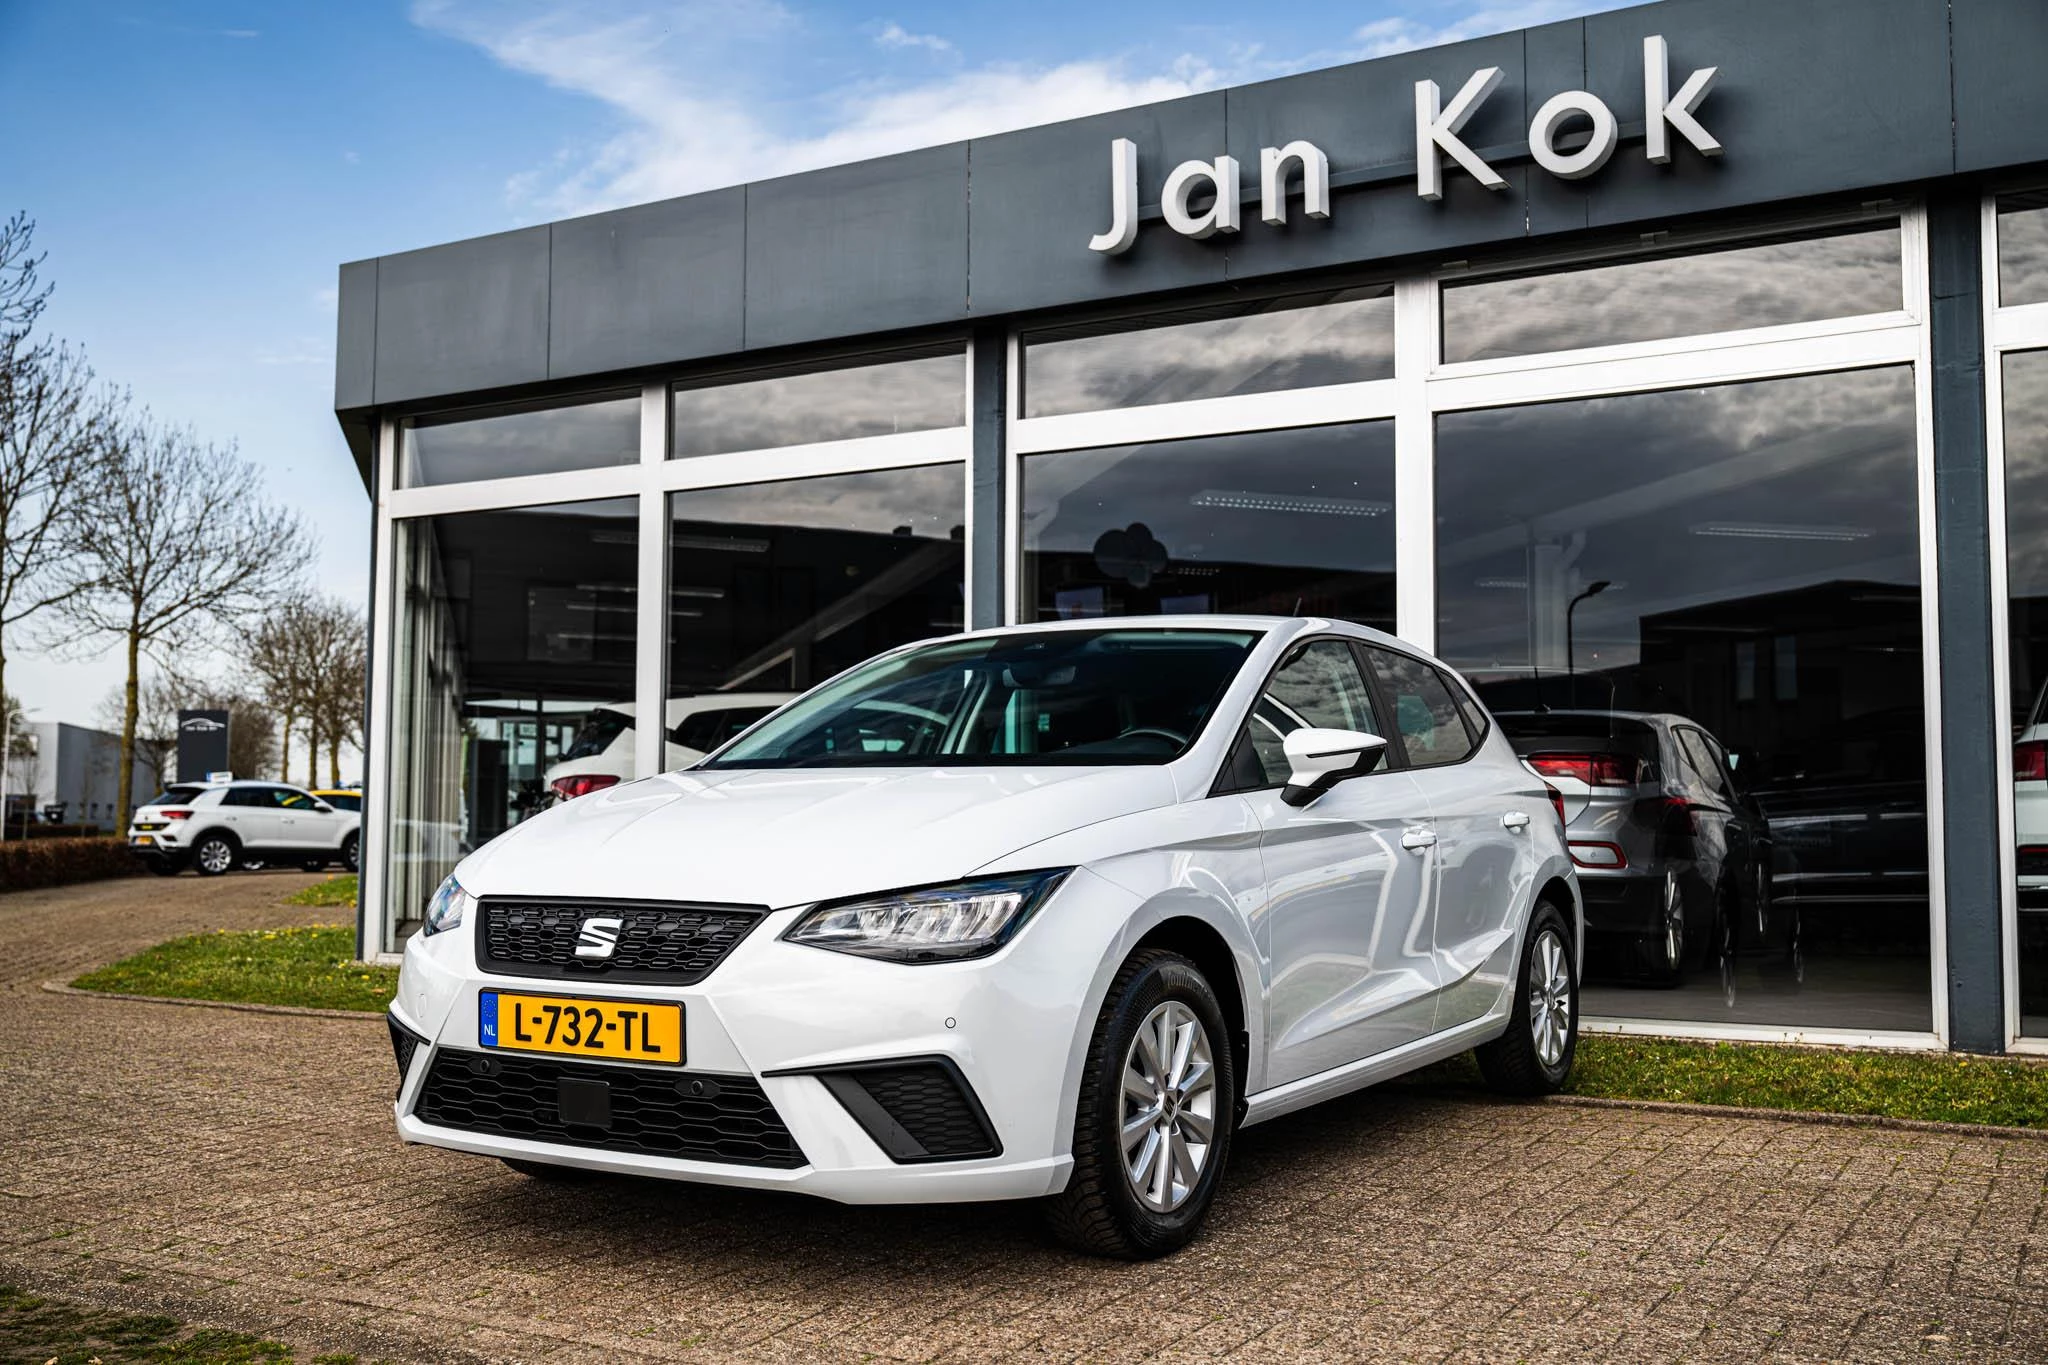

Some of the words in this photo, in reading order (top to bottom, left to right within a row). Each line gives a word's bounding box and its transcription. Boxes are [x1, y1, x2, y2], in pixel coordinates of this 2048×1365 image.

[1088, 138, 1330, 255] Jan
[1415, 34, 1726, 200] Kok
[484, 1023, 496, 1036] NL
[515, 1002, 661, 1053] L-732-TL
